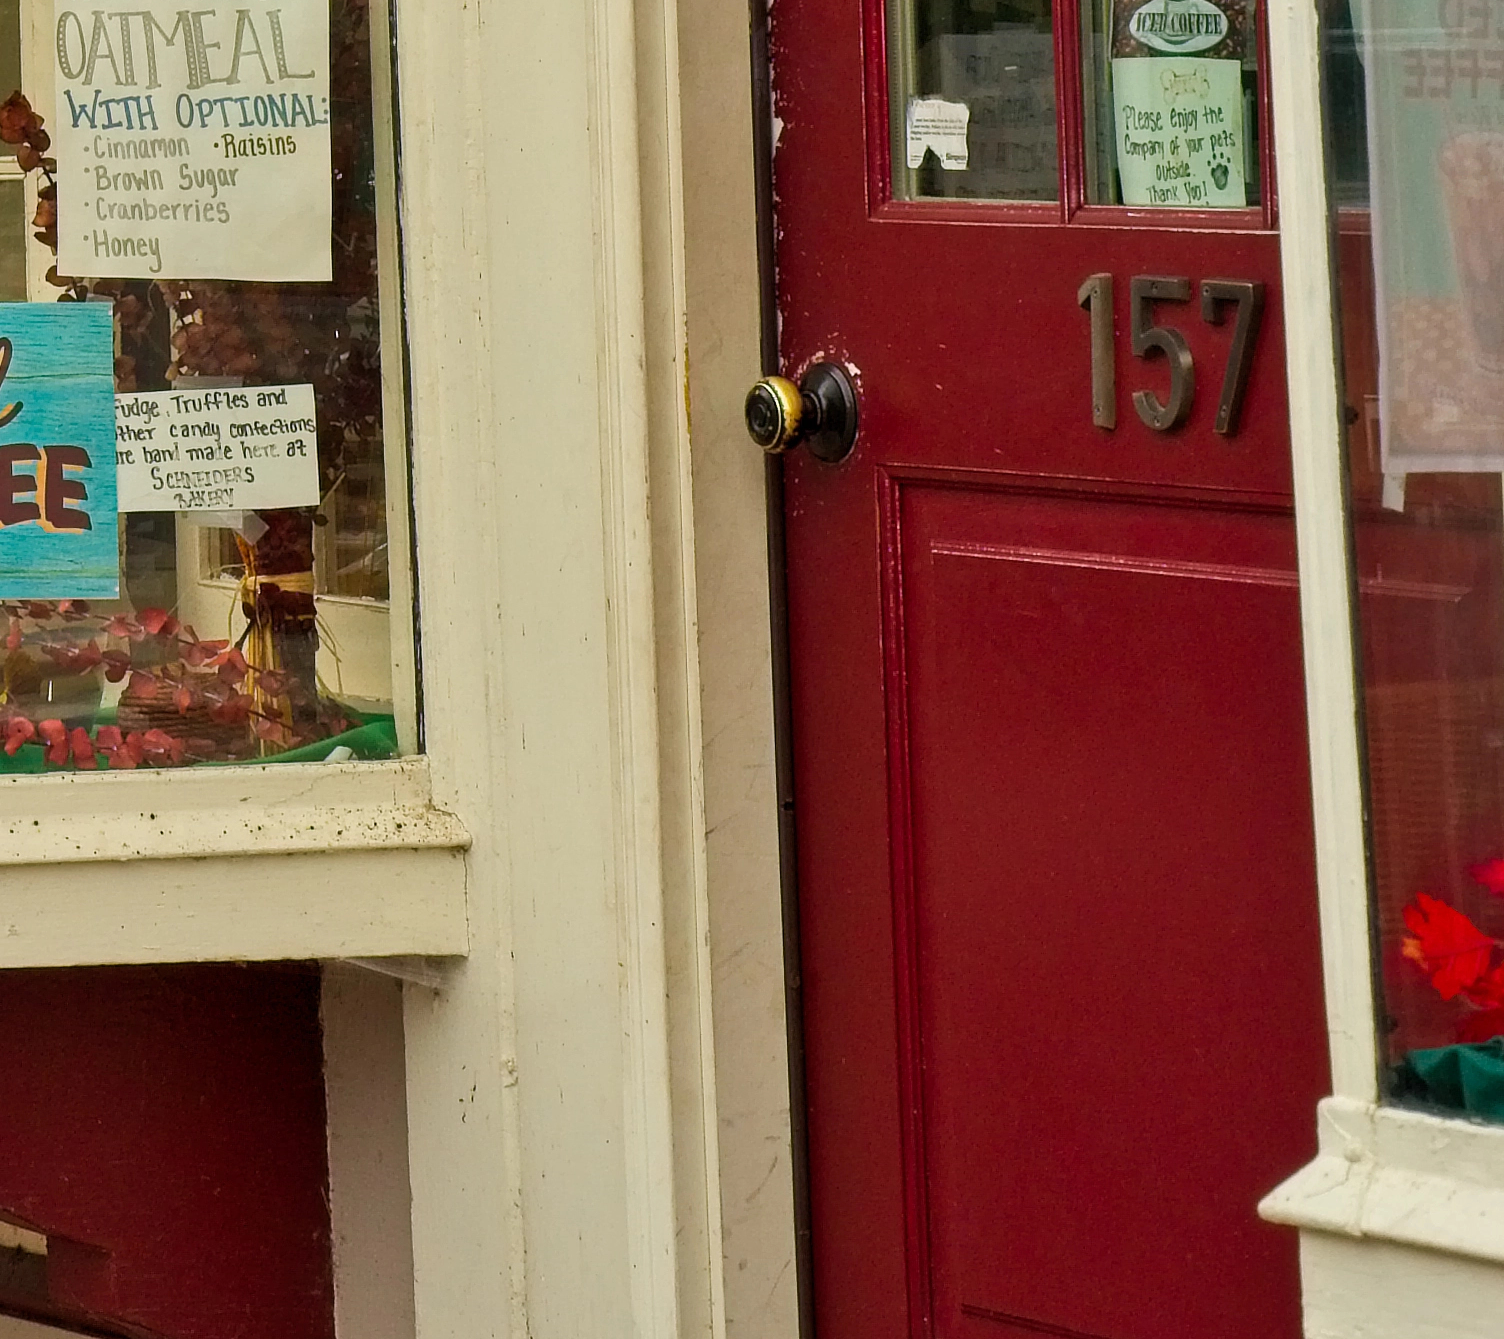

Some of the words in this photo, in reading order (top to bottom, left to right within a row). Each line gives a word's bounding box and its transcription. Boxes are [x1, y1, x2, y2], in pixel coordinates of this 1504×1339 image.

[1135, 11, 1169, 33] ICED
[1170, 13, 1224, 35] COFFEE
[56, 8, 316, 90] OATMEAL
[63, 89, 156, 129] WITH
[175, 92, 330, 129] OPTIONAL:
[1123, 105, 1164, 132] Please
[1170, 107, 1198, 133] enjoy
[1202, 105, 1224, 124] the
[93, 134, 191, 160] Cinnamon
[223, 131, 298, 159] Raisins
[1124, 134, 1165, 161] Company
[1170, 136, 1181, 156] of
[1185, 136, 1205, 157] your
[1210, 130, 1236, 152] pets
[95, 166, 165, 191] Brown
[178, 163, 240, 203] Sugar
[1146, 186, 1179, 204] Thank
[1183, 180, 1208, 206] You!
[95, 196, 231, 224] Cranberries
[93, 235, 163, 273] Honey
[1076, 272, 1263, 435] 157
[170, 391, 249, 415] Truffles
[256, 388, 288, 408] and
[169, 421, 221, 442] candy
[229, 418, 317, 439] confections
[185, 442, 233, 461] made
[286, 439, 308, 458] at
[151, 466, 256, 490] SCHNEIDERS
[173, 488, 234, 510] BAKERY
